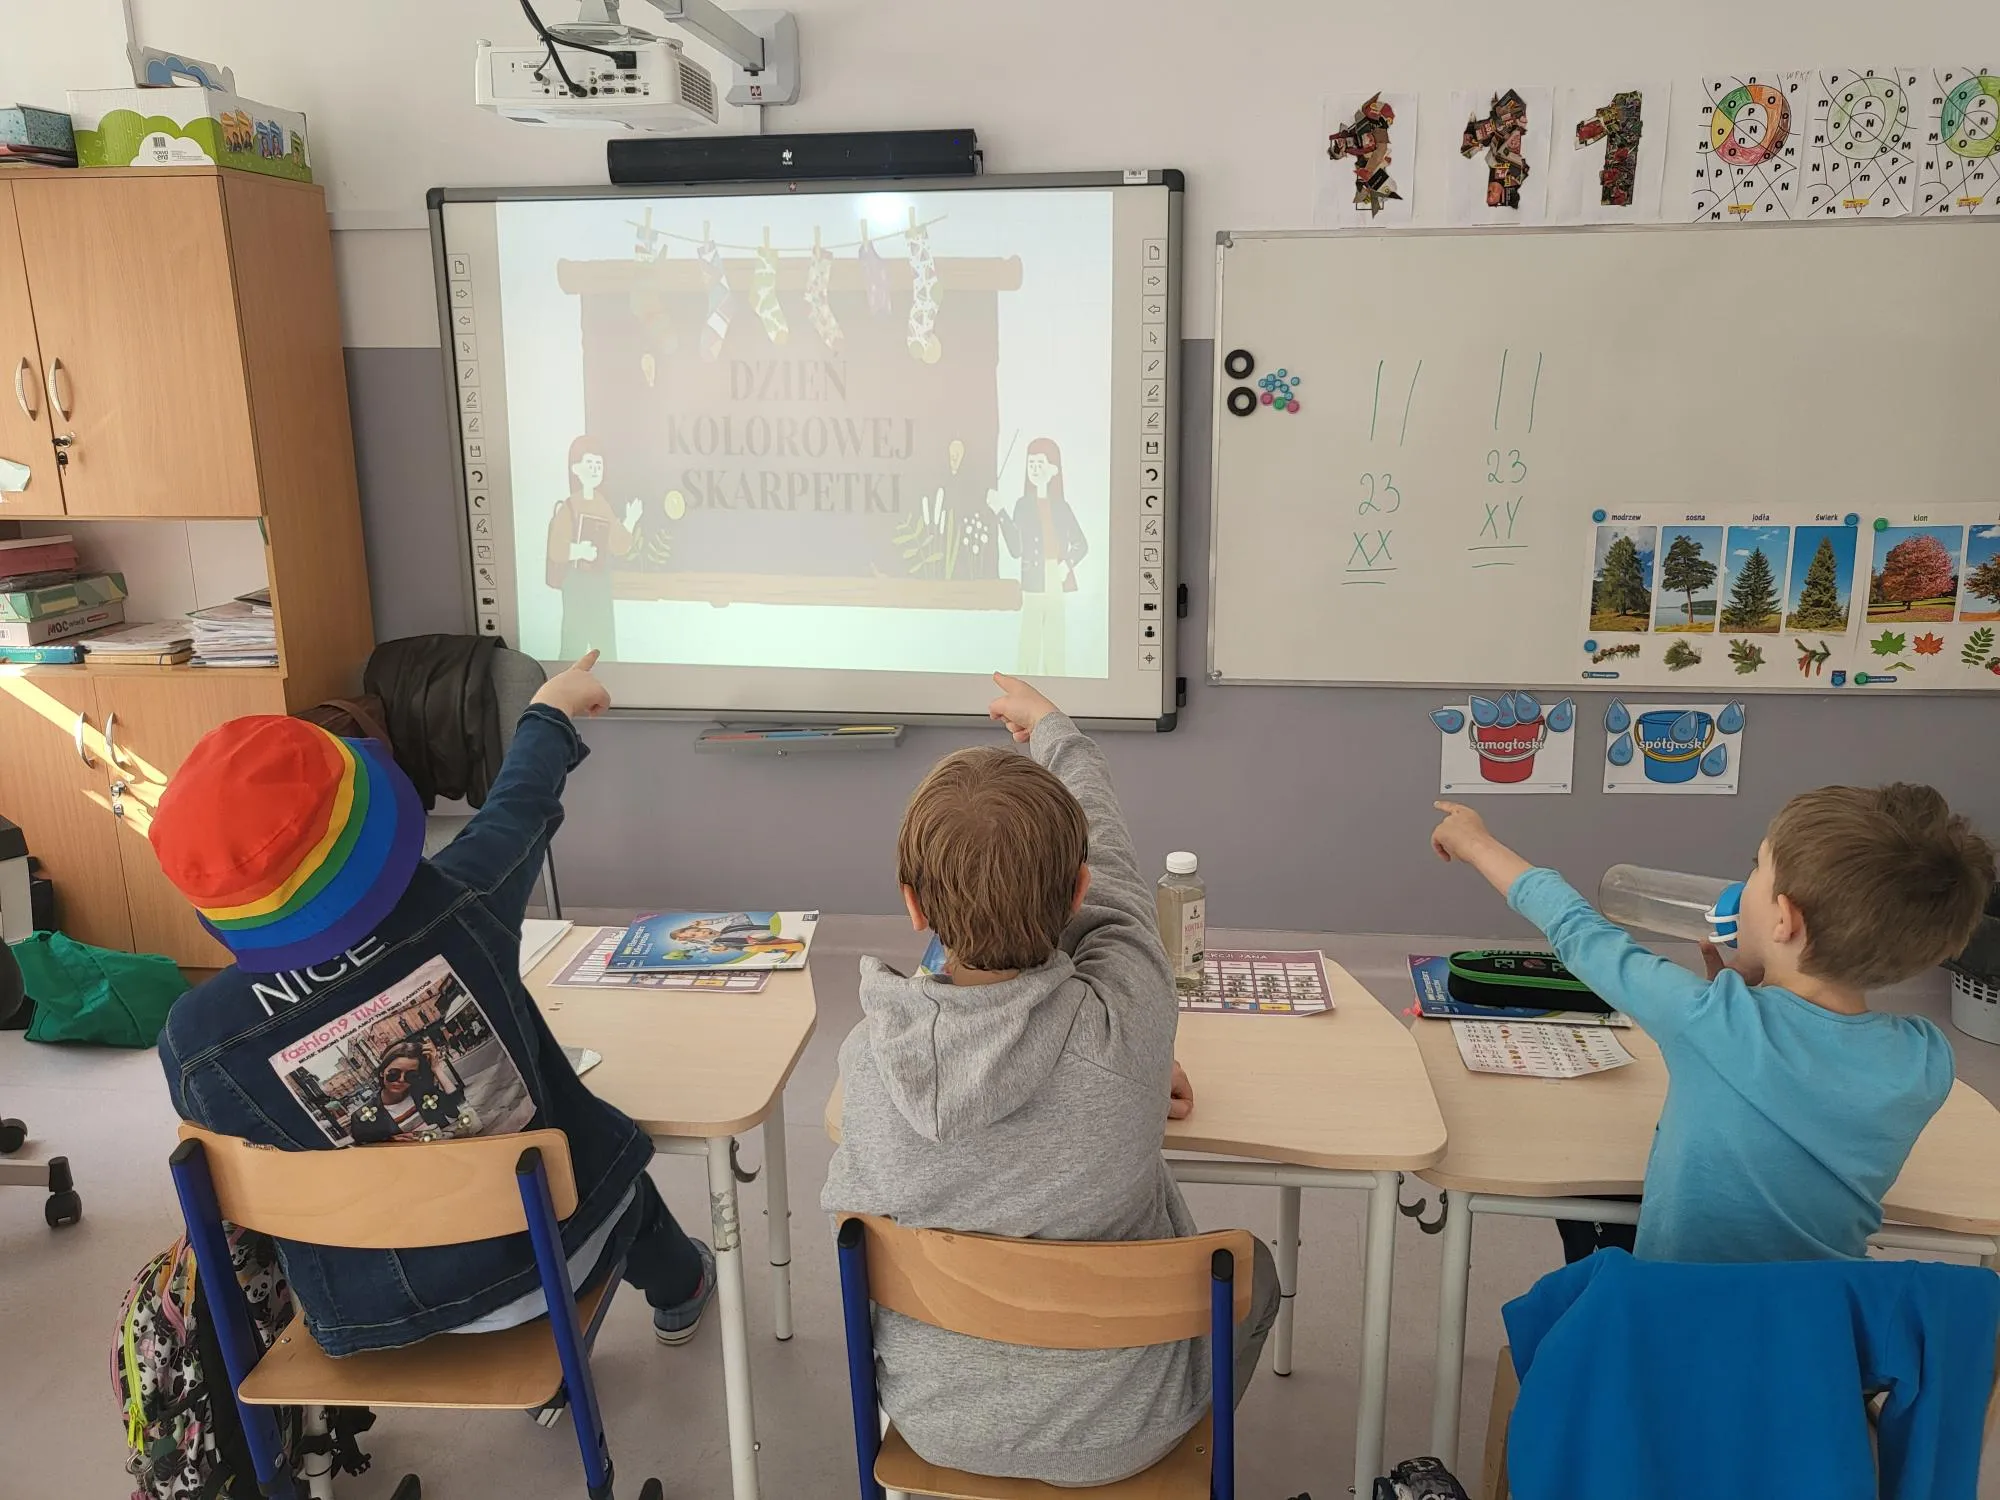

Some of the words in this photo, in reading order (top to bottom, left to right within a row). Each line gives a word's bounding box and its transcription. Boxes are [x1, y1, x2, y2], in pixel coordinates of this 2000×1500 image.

[1866, 69, 1874, 77] n
[1980, 68, 1988, 76] n
[1749, 76, 1756, 84] n
[1818, 99, 1829, 107] m
[1932, 97, 1943, 105] m
[1702, 106, 1713, 114] m
[1866, 118, 1875, 128] N
[1980, 116, 1989, 126] N
[1749, 125, 1758, 134] N
[1854, 130, 1862, 138] n
[1968, 128, 1976, 136] n
[1738, 137, 1746, 145] n
[1814, 135, 1824, 144] M
[1928, 132, 1939, 141] M
[1698, 141, 1709, 150] M
[1901, 141, 1911, 150] M
[1784, 147, 1795, 157] M
[1811, 163, 1820, 172] N
[1853, 161, 1861, 169] n
[1925, 161, 1934, 170] N
[1967, 159, 1975, 167] n
[1696, 169, 1704, 178] N
[1859, 174, 1871, 182] m
[1973, 172, 1984, 180] m
[1743, 180, 1754, 188] m
[1898, 175, 1907, 185] N
[1781, 182, 1790, 191] N
[1826, 206, 1836, 215] M
[1939, 204, 1949, 213] M
[1711, 211, 1721, 220] M
[729, 351, 849, 401] DZIEŃ
[666, 414, 917, 459] KOLOROWEJ
[1487, 449, 1527, 483] 23
[681, 468, 902, 513] SKARPETKI
[1358, 472, 1400, 515] 23
[1480, 495, 1524, 539] XY
[1752, 513, 1770, 522] jodła
[1815, 513, 1838, 521] świerk
[1913, 514, 1928, 522] klon
[1348, 529, 1393, 567] XX
[1469, 737, 1544, 752] samogłoski
[251, 935, 386, 1017] NICE
[281, 1018, 349, 1063] fashion9
[350, 994, 392, 1022] TIME
